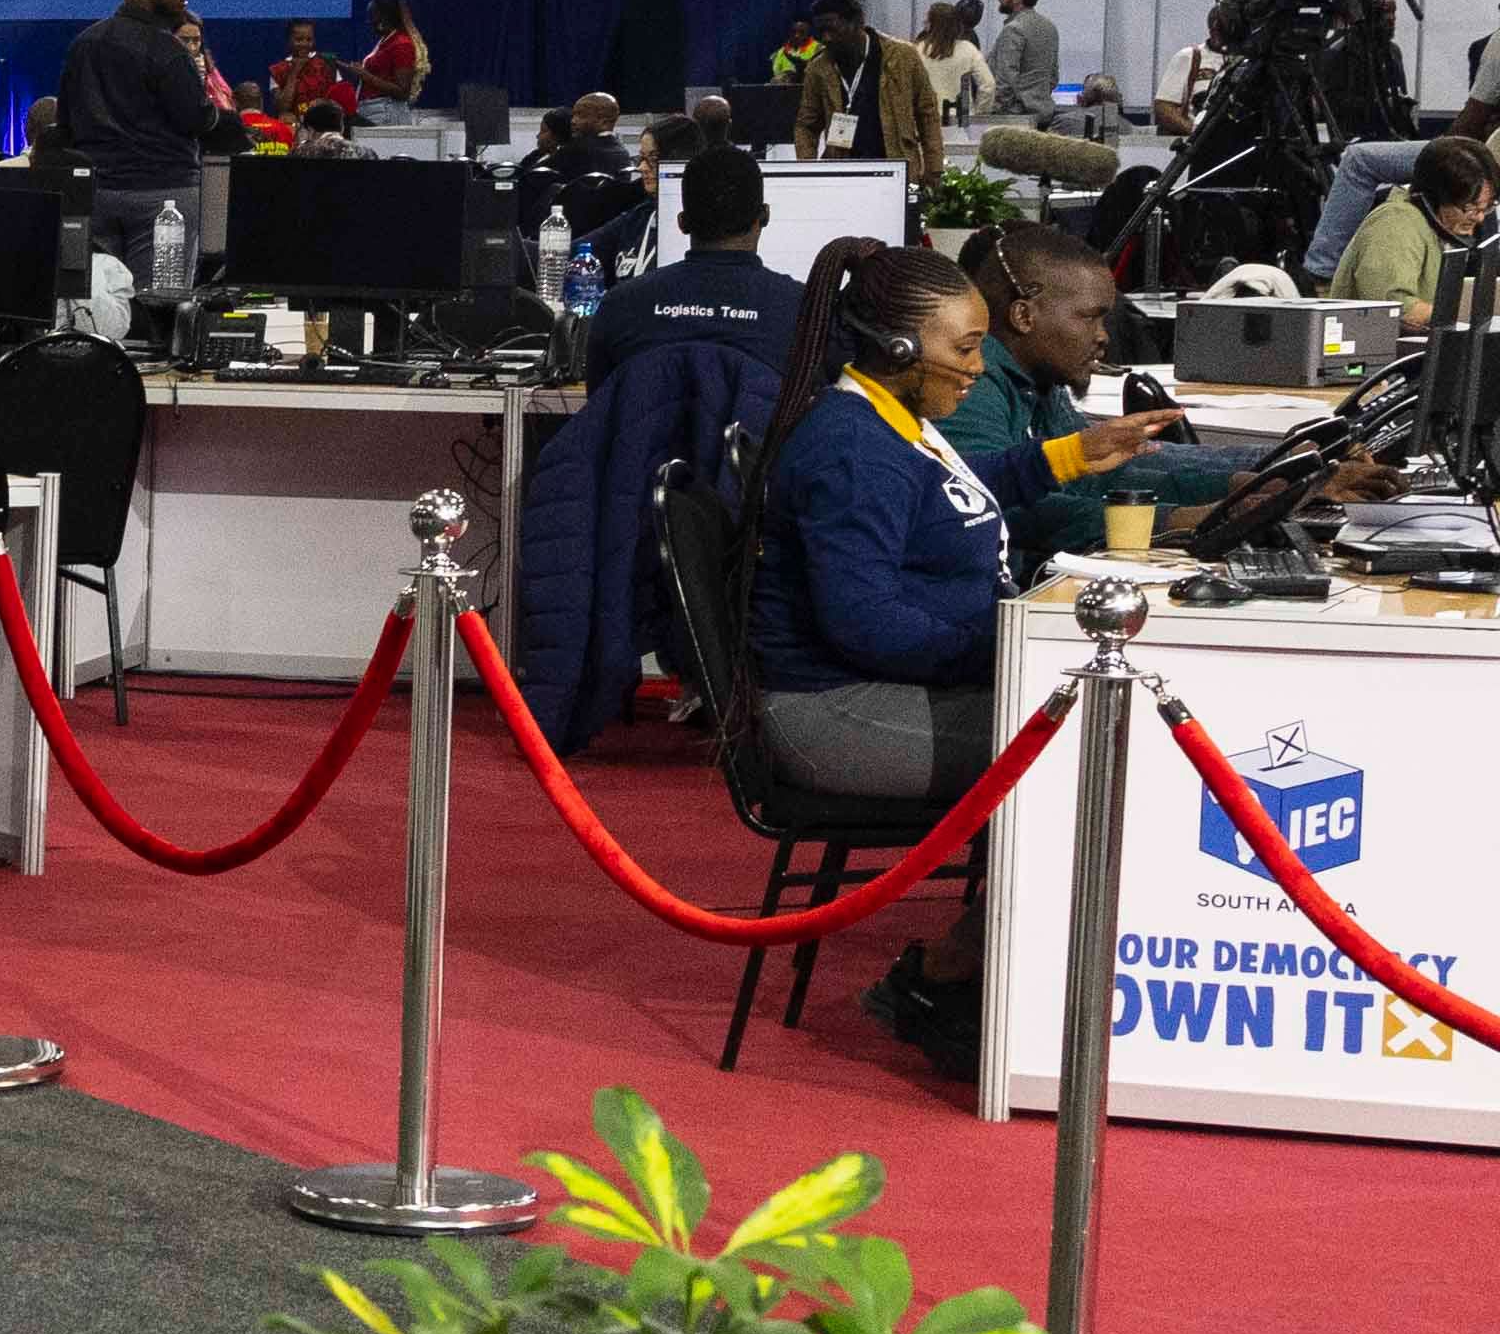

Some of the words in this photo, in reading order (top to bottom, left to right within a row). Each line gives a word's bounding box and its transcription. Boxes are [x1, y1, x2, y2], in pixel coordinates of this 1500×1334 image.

[654, 304, 714, 317] Logistics
[721, 306, 758, 320] Team
[1288, 796, 1357, 852] IEC
[1197, 893, 1271, 912] SOUTH
[1116, 933, 1199, 970] OUR
[1303, 989, 1374, 1054] IT
